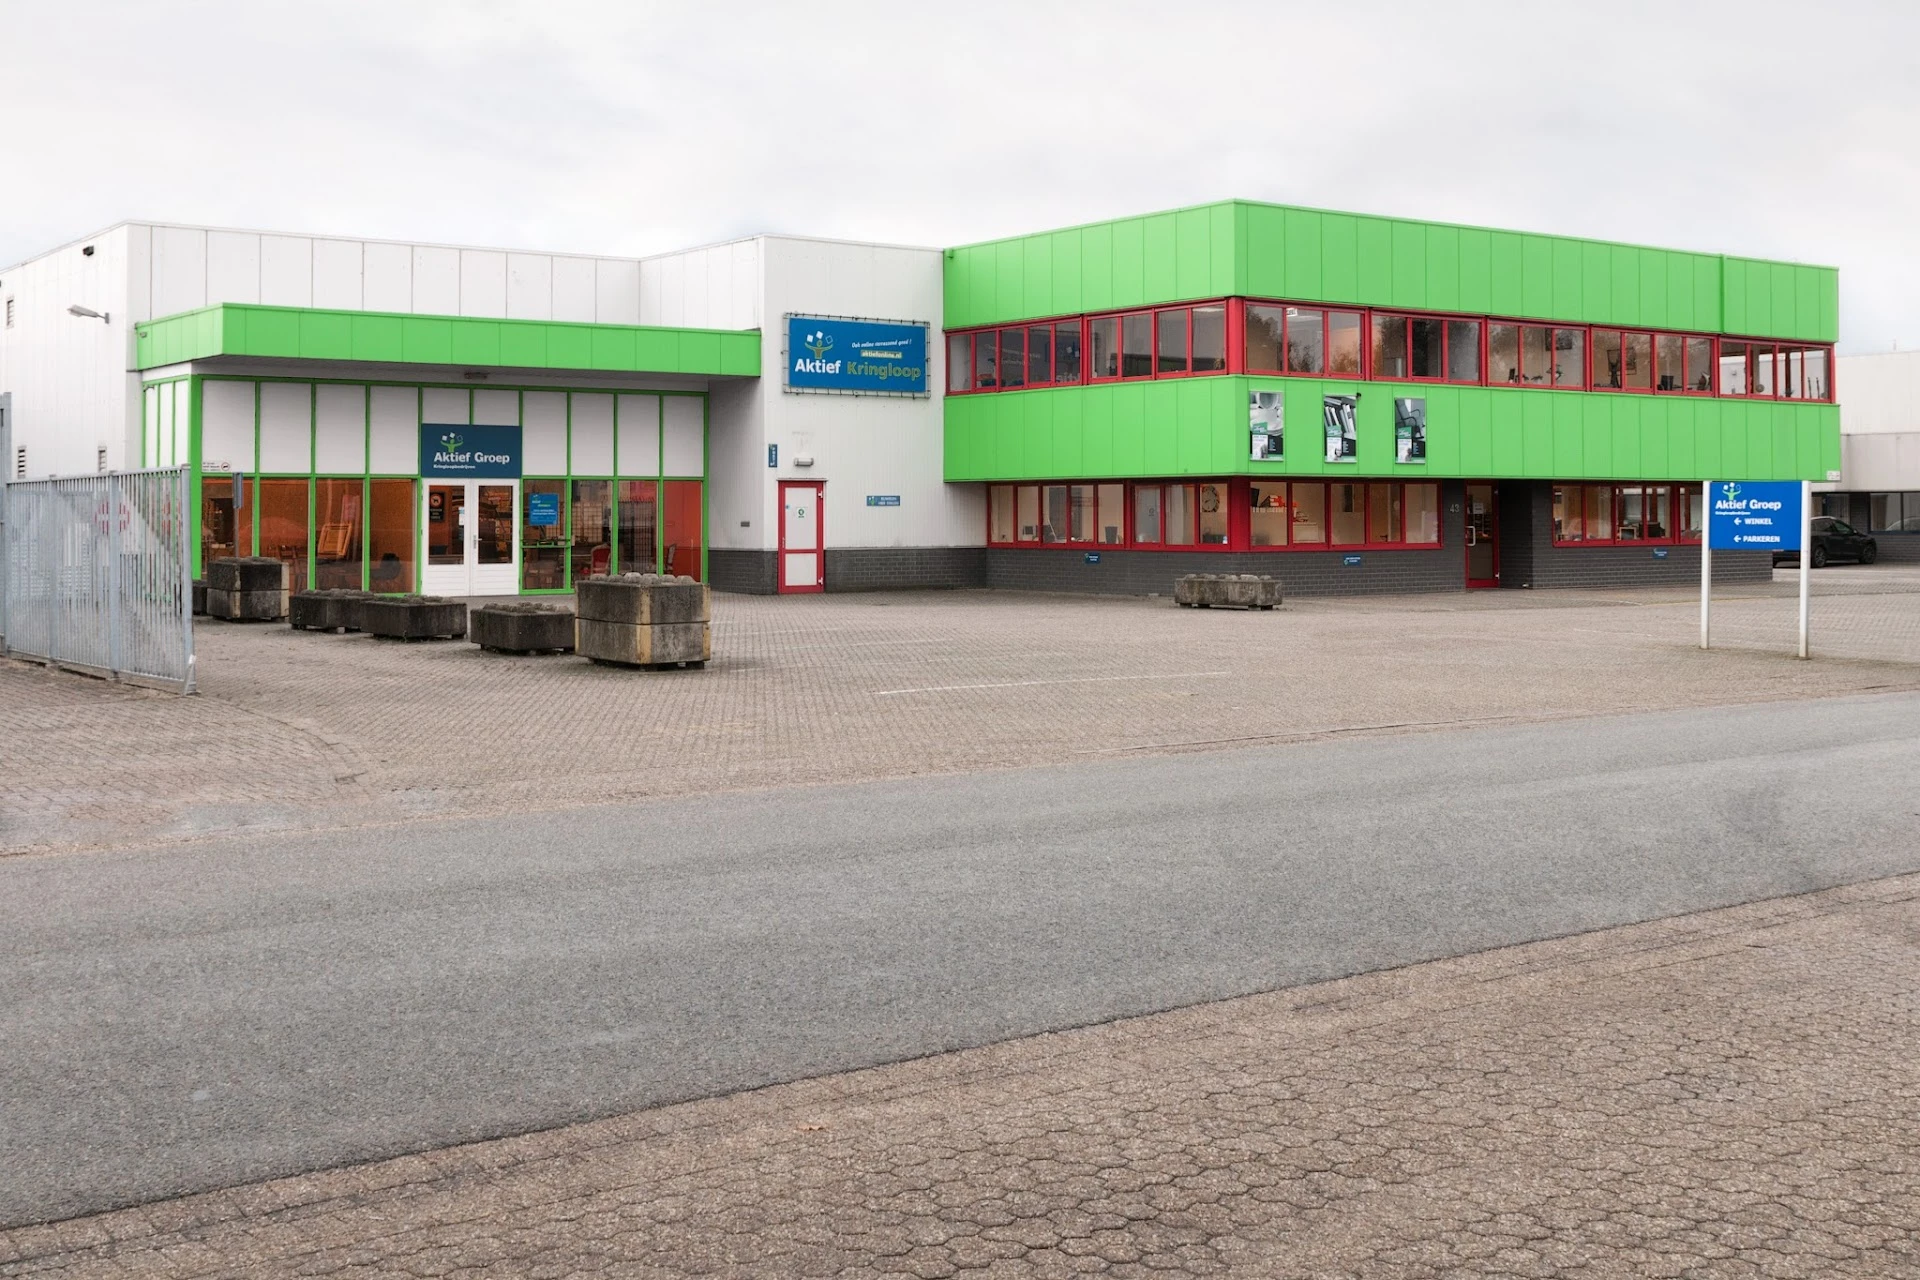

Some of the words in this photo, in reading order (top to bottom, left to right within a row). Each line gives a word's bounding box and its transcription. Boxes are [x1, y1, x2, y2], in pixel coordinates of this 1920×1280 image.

[794, 358, 841, 373] Aktief
[847, 361, 921, 380] Kringloop
[433, 452, 471, 462] Aktief
[474, 452, 510, 464] Groep
[1450, 504, 1460, 513] 43
[1715, 500, 1747, 509] Aktief
[1749, 500, 1782, 510] Groep
